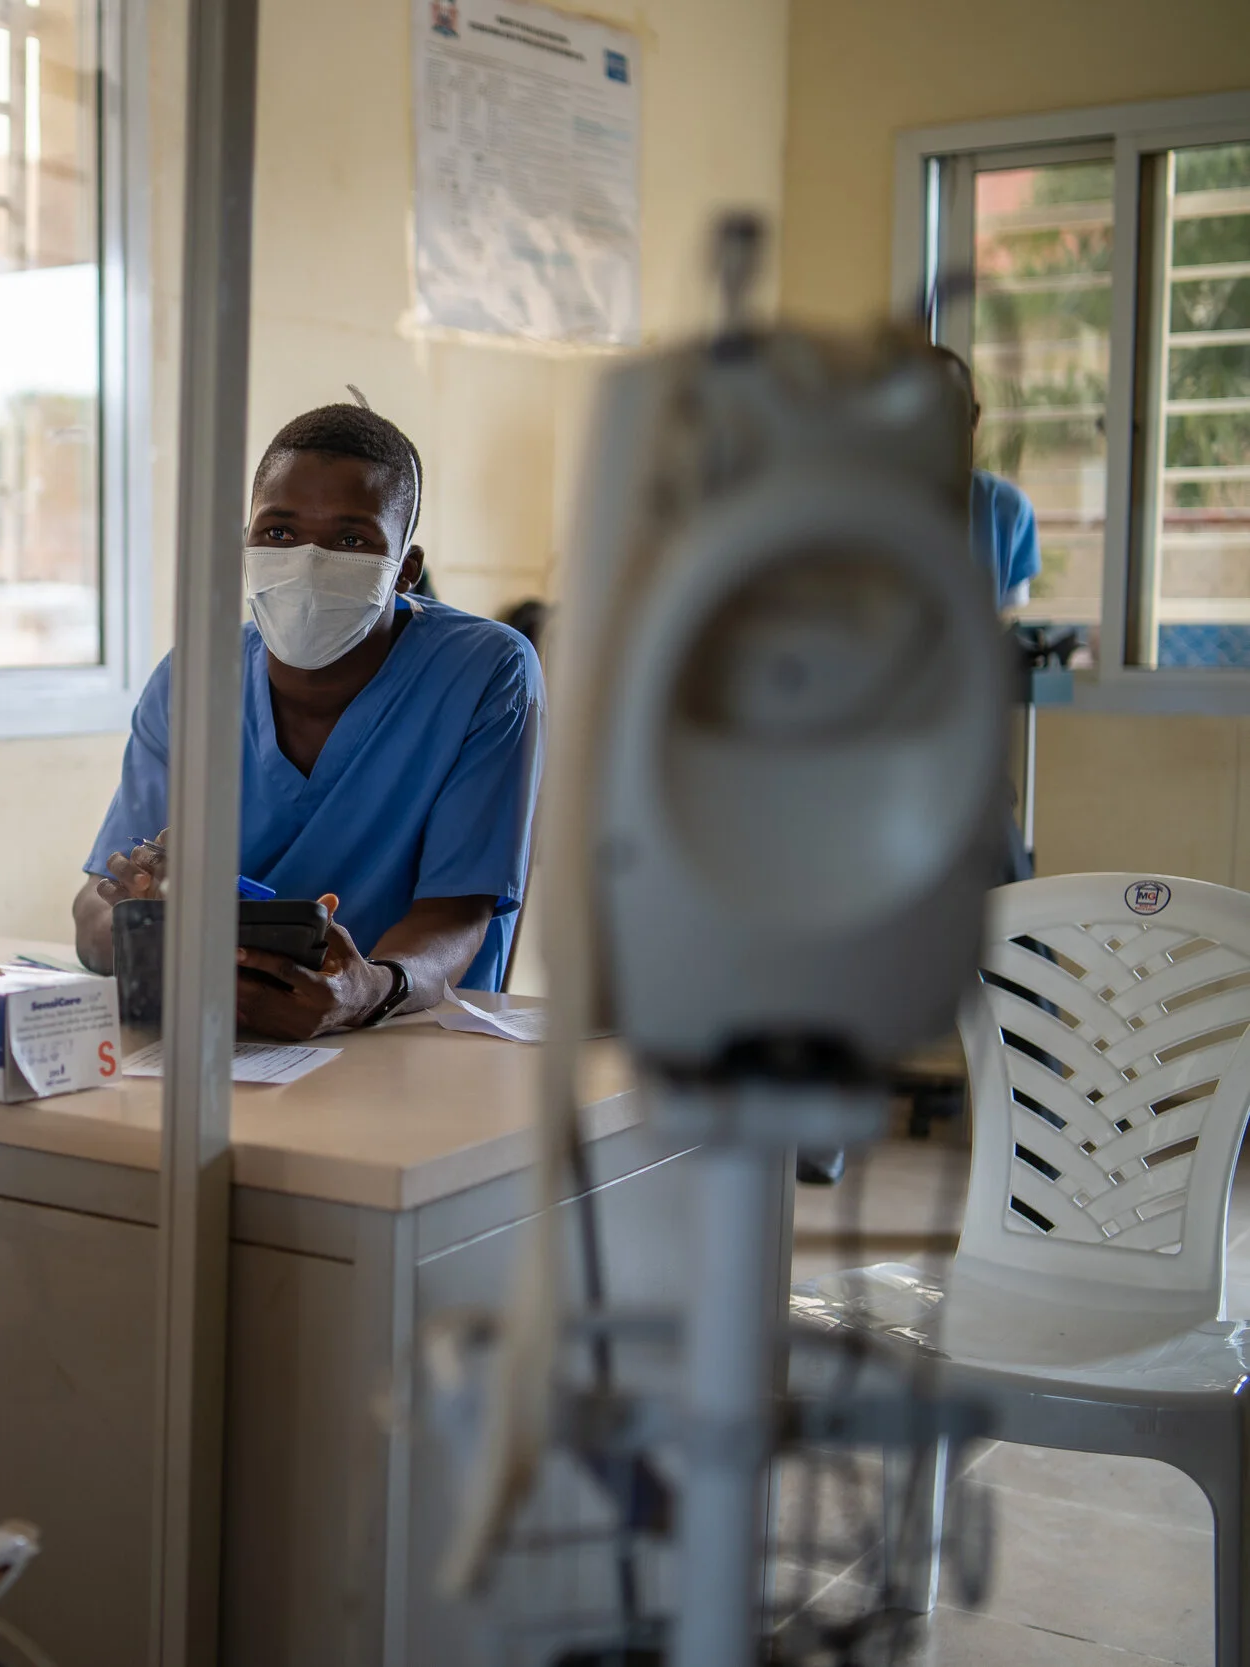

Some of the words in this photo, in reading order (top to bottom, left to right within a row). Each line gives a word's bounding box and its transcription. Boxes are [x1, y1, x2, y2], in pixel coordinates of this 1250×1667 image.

[1138, 892, 1156, 900] MG
[31, 997, 81, 1012] SensiCare
[98, 1040, 117, 1077] S
